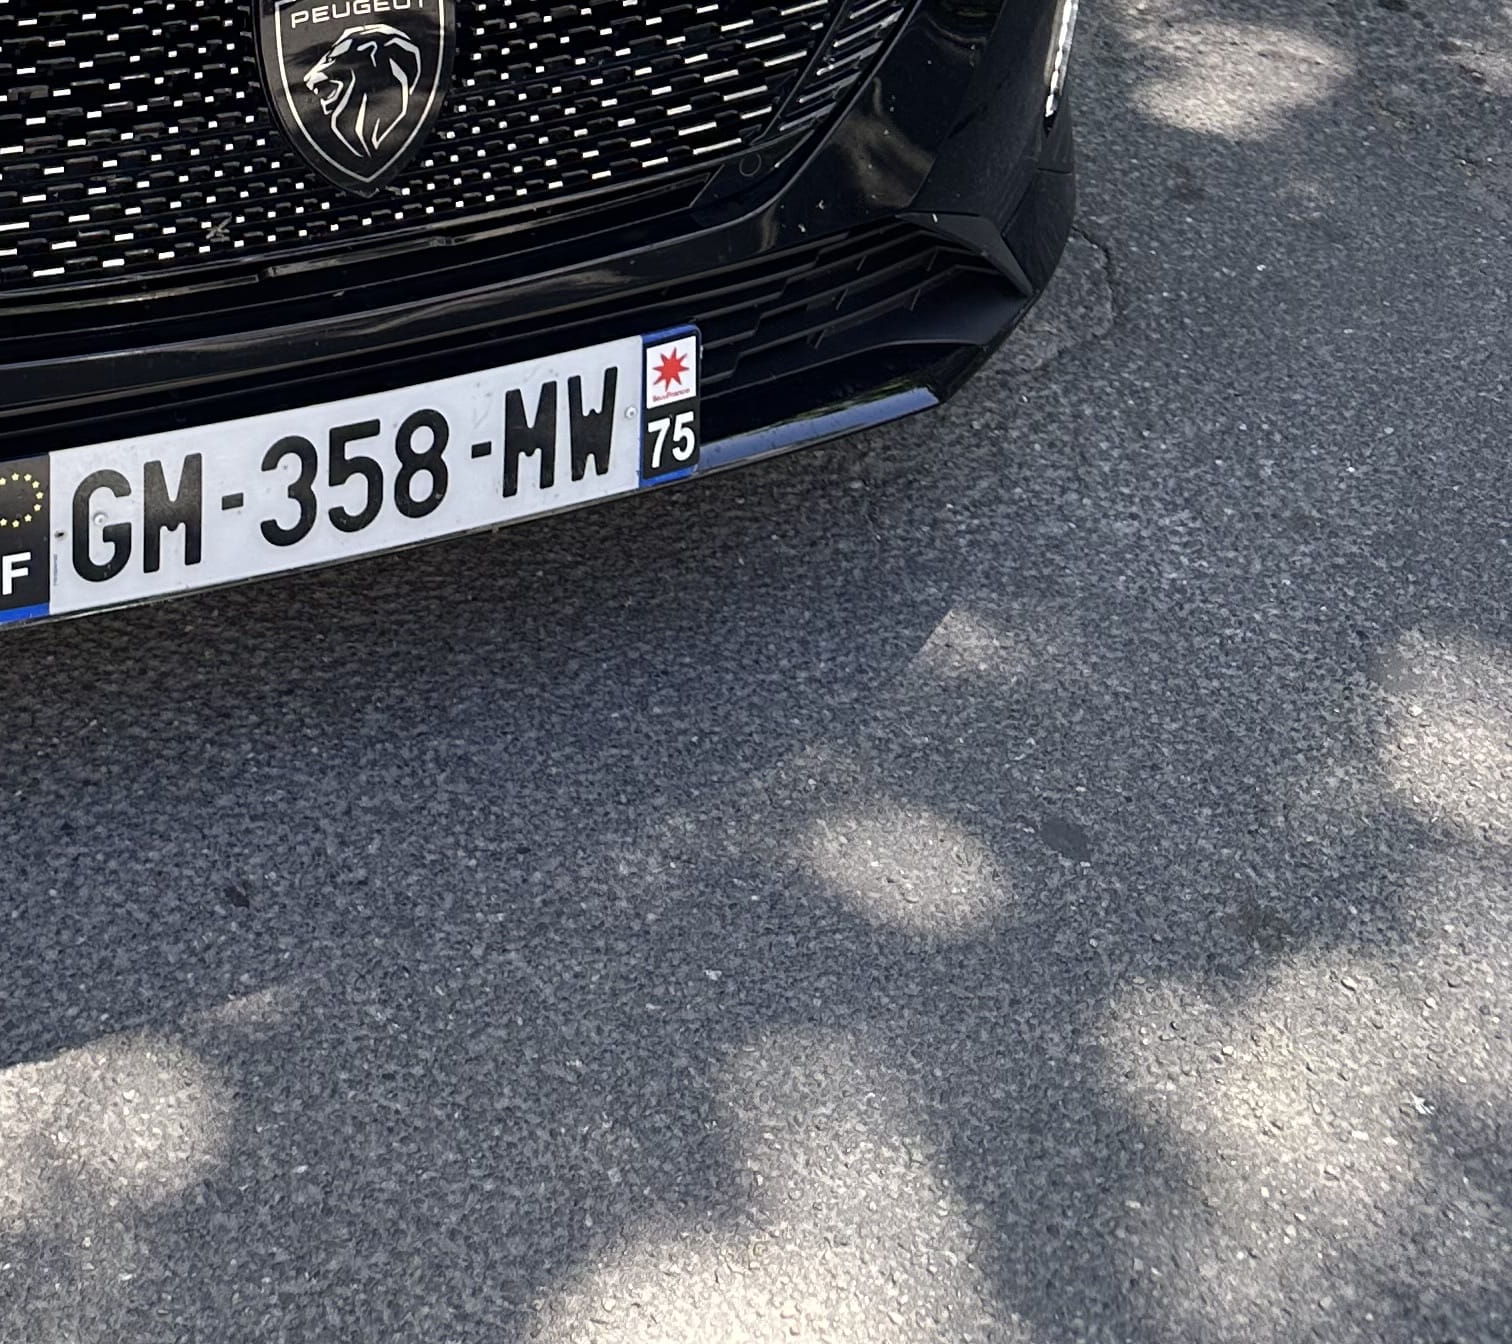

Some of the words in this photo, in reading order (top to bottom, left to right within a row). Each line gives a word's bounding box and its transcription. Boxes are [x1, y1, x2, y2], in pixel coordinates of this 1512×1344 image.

[1, 552, 32, 596] F
[71, 365, 619, 583] GM-358-MW
[647, 411, 695, 469] 75
